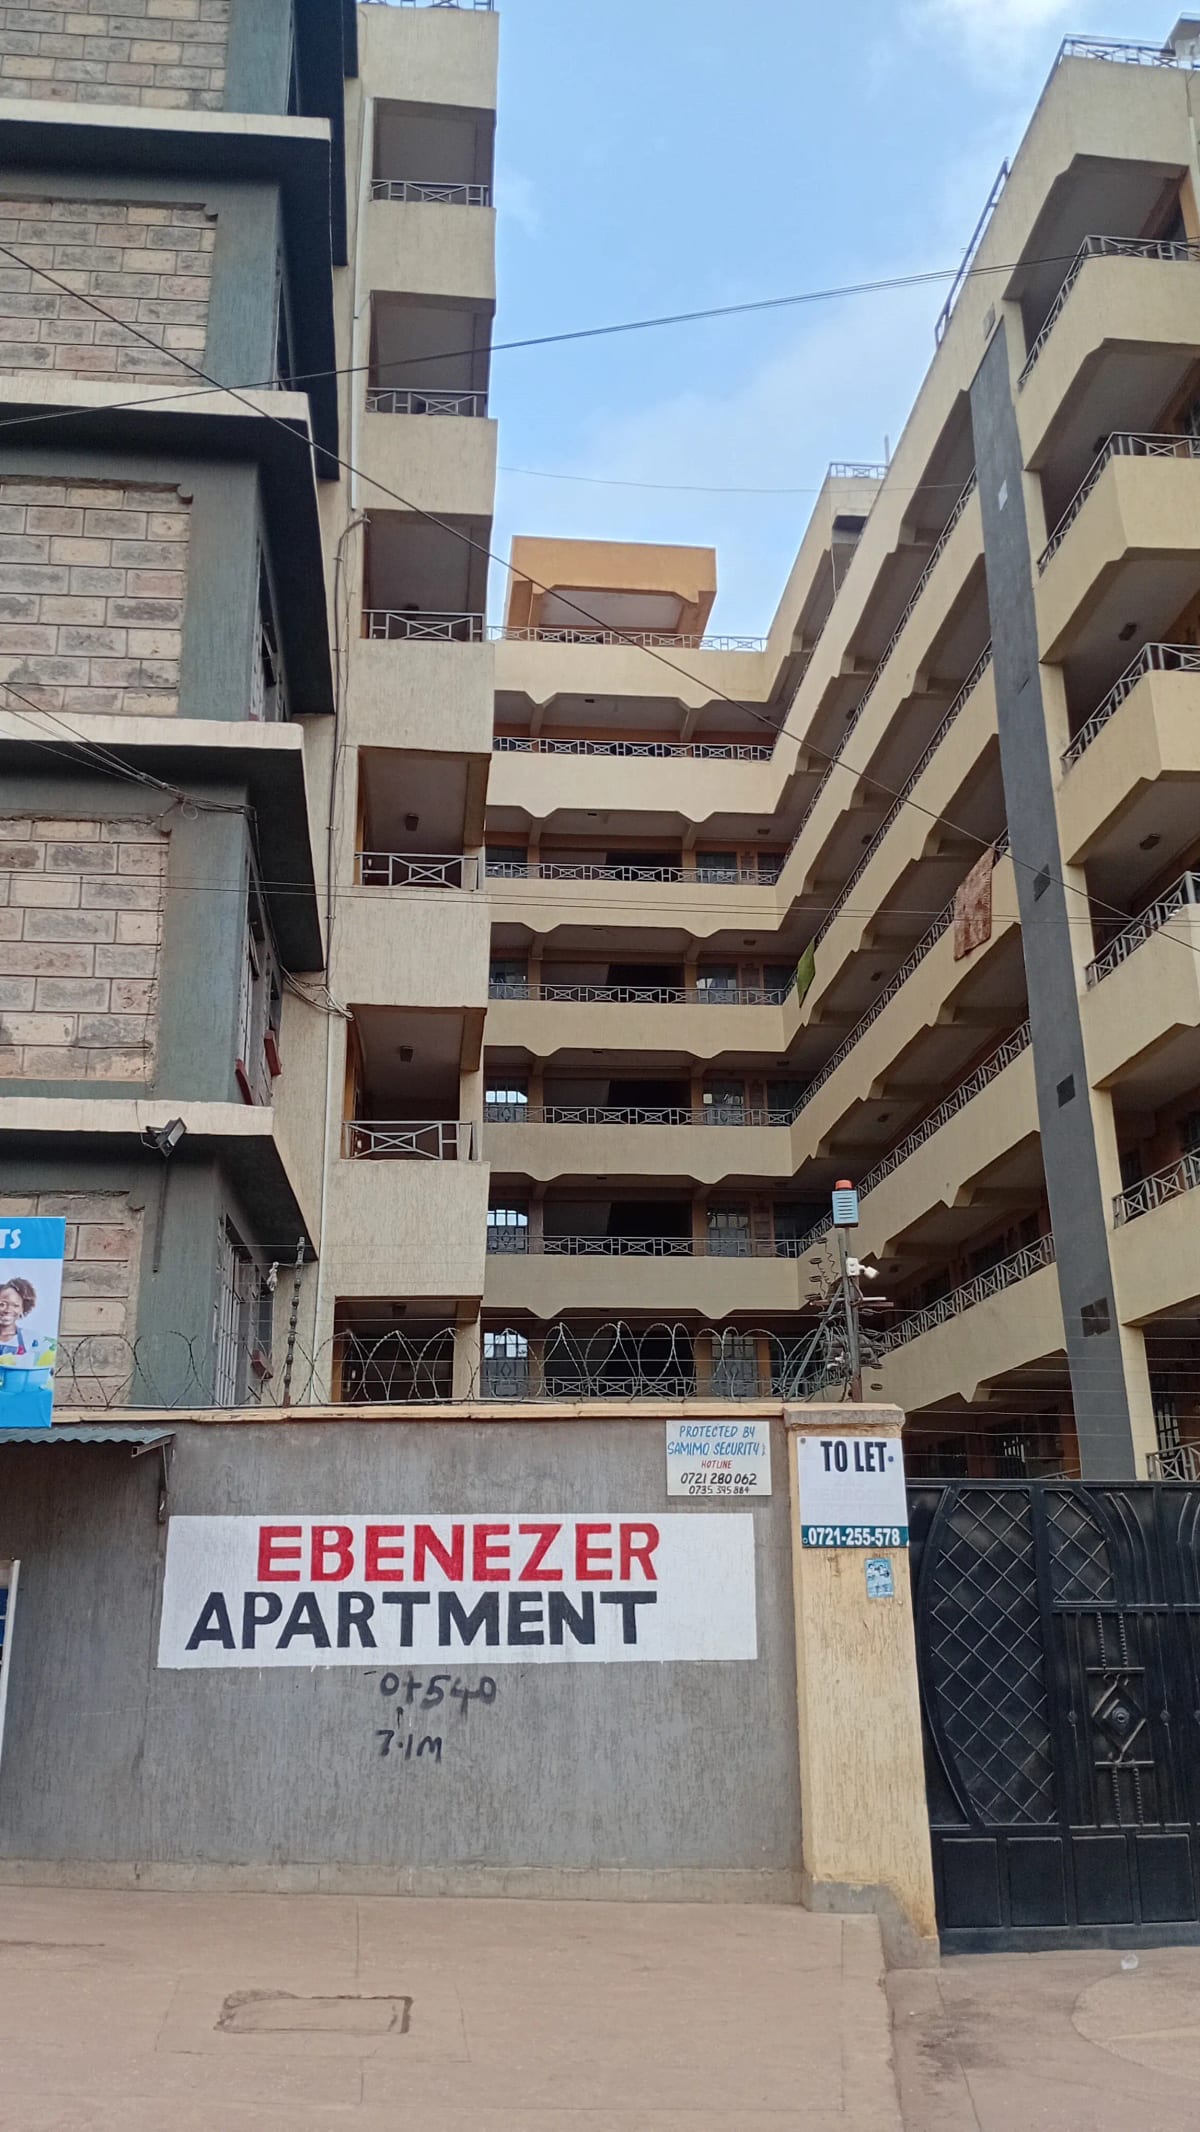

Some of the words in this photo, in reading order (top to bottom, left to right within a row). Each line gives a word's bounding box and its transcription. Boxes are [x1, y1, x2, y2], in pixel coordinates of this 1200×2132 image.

[679, 1425, 738, 1438] PROTECTED
[742, 1426, 756, 1438] BY
[667, 1441, 710, 1456] SAMIMO
[713, 1441, 760, 1456] SECURITY
[820, 1440, 848, 1473] TO
[853, 1441, 887, 1473] LET
[701, 1460, 733, 1469] HOTLINE
[680, 1472, 707, 1485] 0721
[710, 1473, 733, 1485] 280
[734, 1473, 758, 1486] 062
[688, 1485, 713, 1495] 0735
[808, 1527, 900, 1546] 0721-255-578
[257, 1522, 661, 1583] EBENEZER
[185, 1590, 657, 1651] APARTMENT
